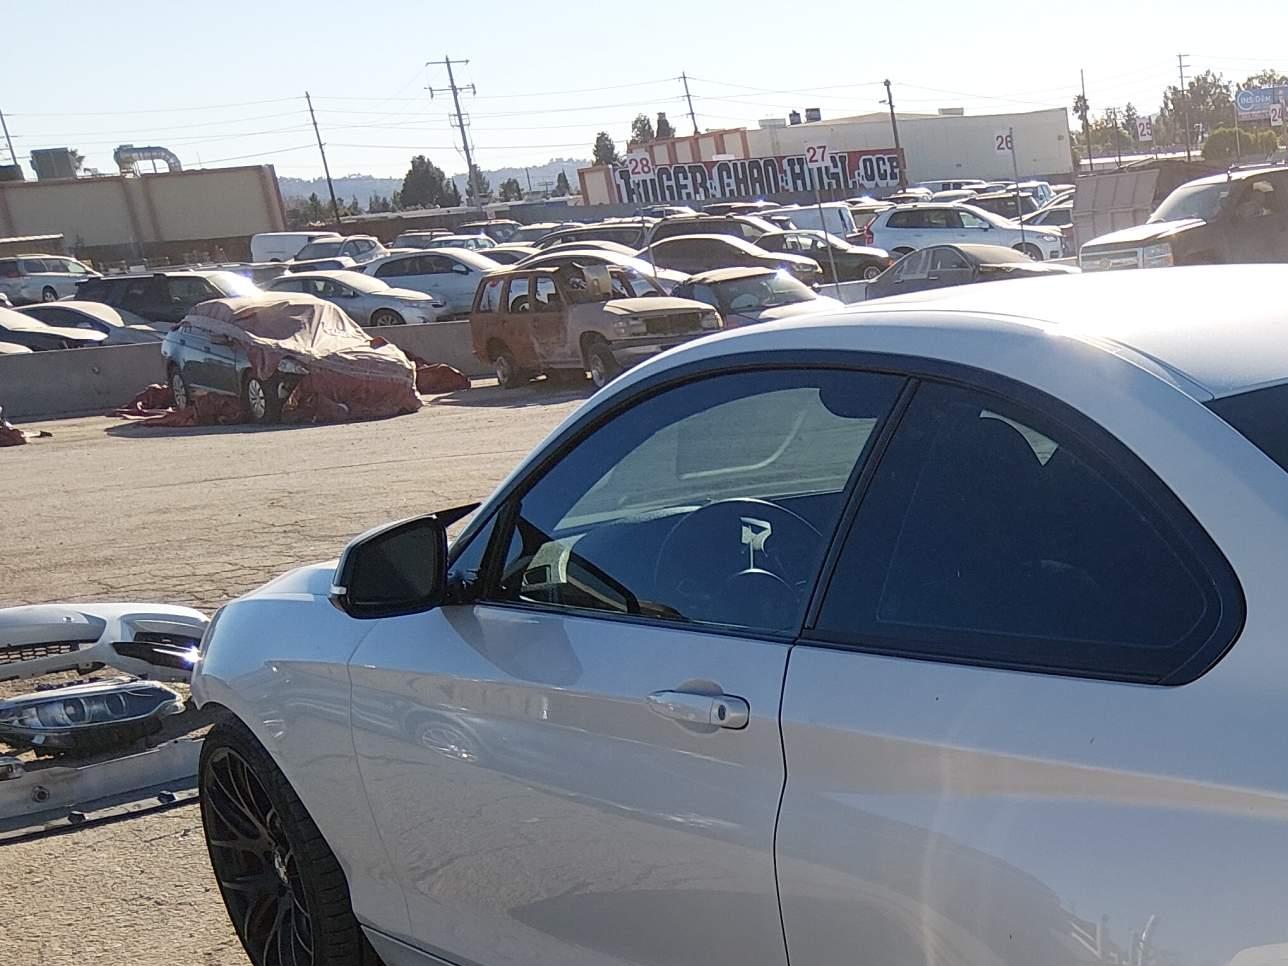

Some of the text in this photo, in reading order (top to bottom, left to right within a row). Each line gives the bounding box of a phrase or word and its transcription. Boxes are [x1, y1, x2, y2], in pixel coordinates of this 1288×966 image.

[1270, 108, 1283, 122] 24
[1138, 122, 1153, 137] 25
[996, 134, 1013, 151] 26
[806, 145, 827, 163] 27
[628, 157, 651, 175] 28
